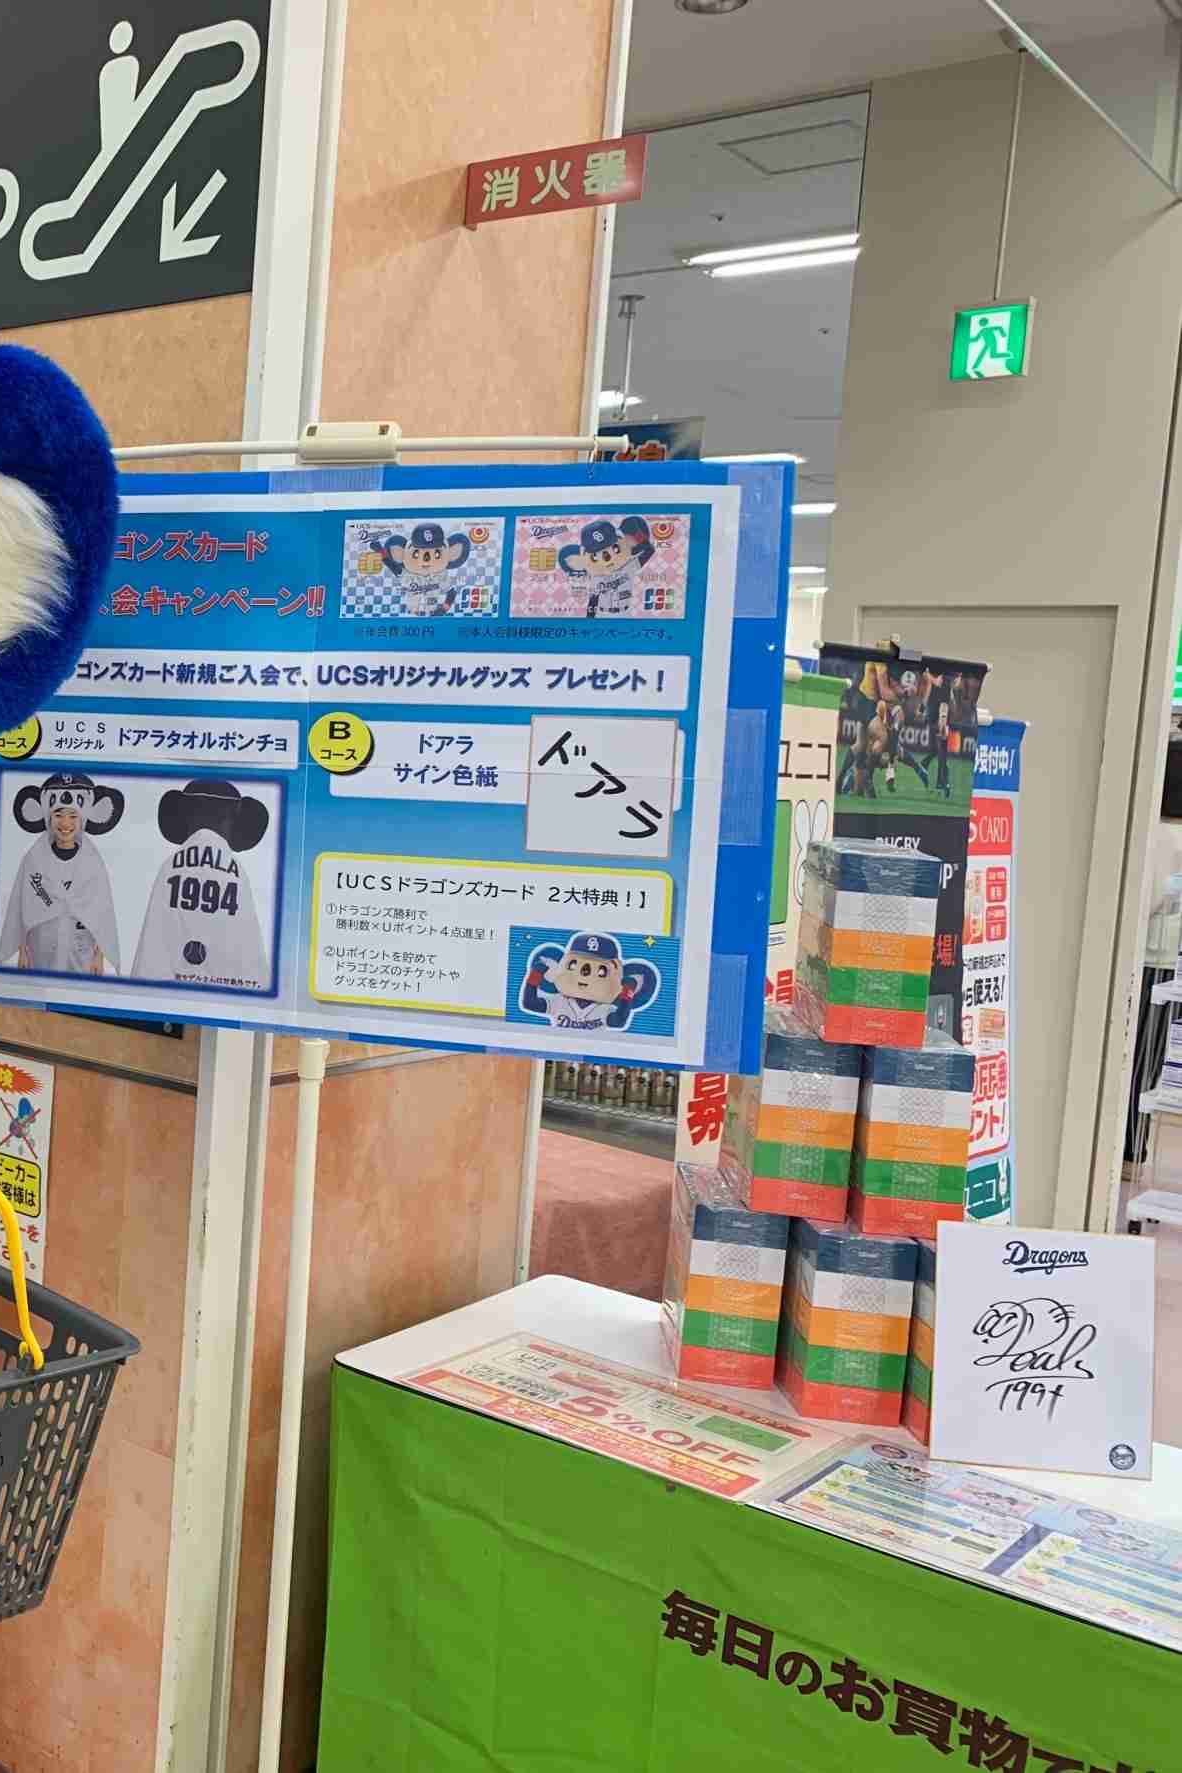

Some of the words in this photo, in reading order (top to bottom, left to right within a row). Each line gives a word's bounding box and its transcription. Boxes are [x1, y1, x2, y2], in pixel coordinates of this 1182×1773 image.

[481, 149, 628, 213] 消火器
[99, 584, 326, 617] 会キャンペーン!!
[329, 720, 351, 740] B
[54, 738, 105, 751] オリジナル
[320, 747, 358, 761] コース
[419, 733, 475, 756] ドアラ
[393, 763, 498, 788] サイン色紙
[978, 815, 1010, 844] CARD
[167, 874, 239, 916] 1994
[335, 960, 461, 981] ドラゴンズのチケットや
[1002, 1240, 1090, 1275] Dragons
[661, 1589, 1158, 1773] 毎日のお買物
